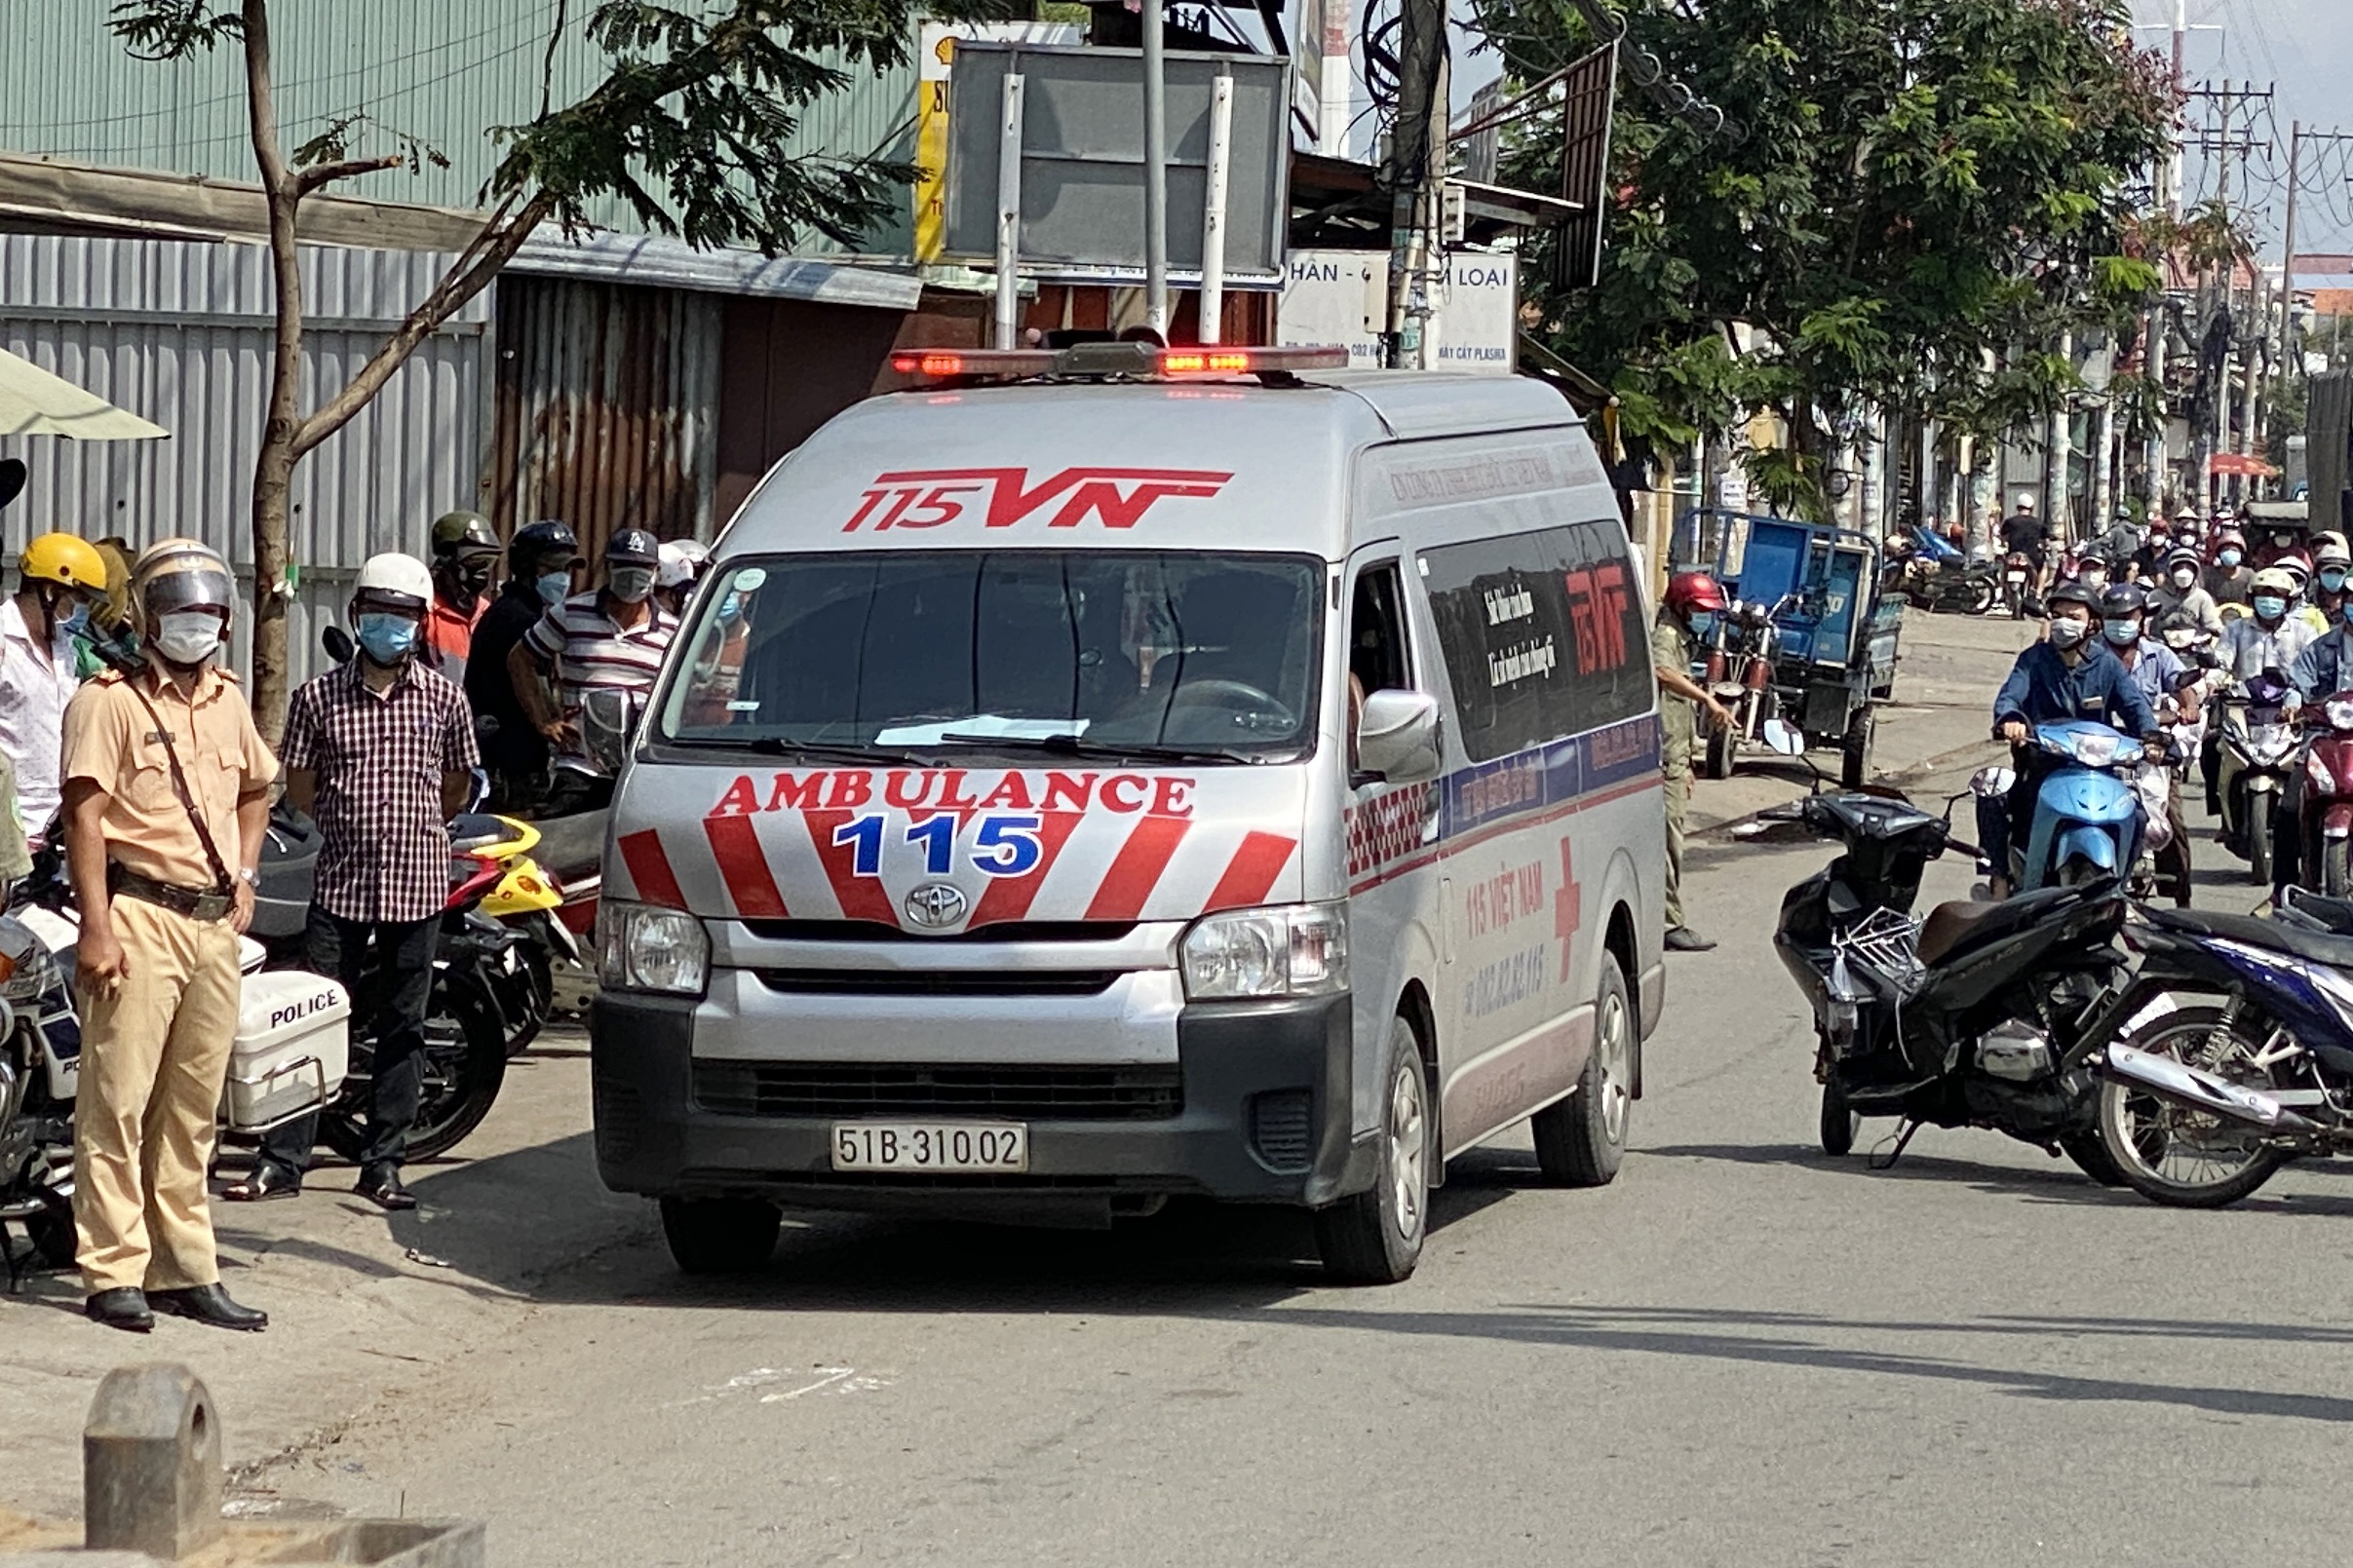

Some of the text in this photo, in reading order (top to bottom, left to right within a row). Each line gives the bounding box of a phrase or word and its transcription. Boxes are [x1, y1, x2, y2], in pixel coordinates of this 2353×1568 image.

[1458, 268, 1507, 290] LOẠI
[709, 771, 1196, 818] AMBULANCE
[832, 811, 1044, 878] 115
[271, 988, 338, 1029] POLICE
[839, 1128, 1020, 1165] 51B-310.02
